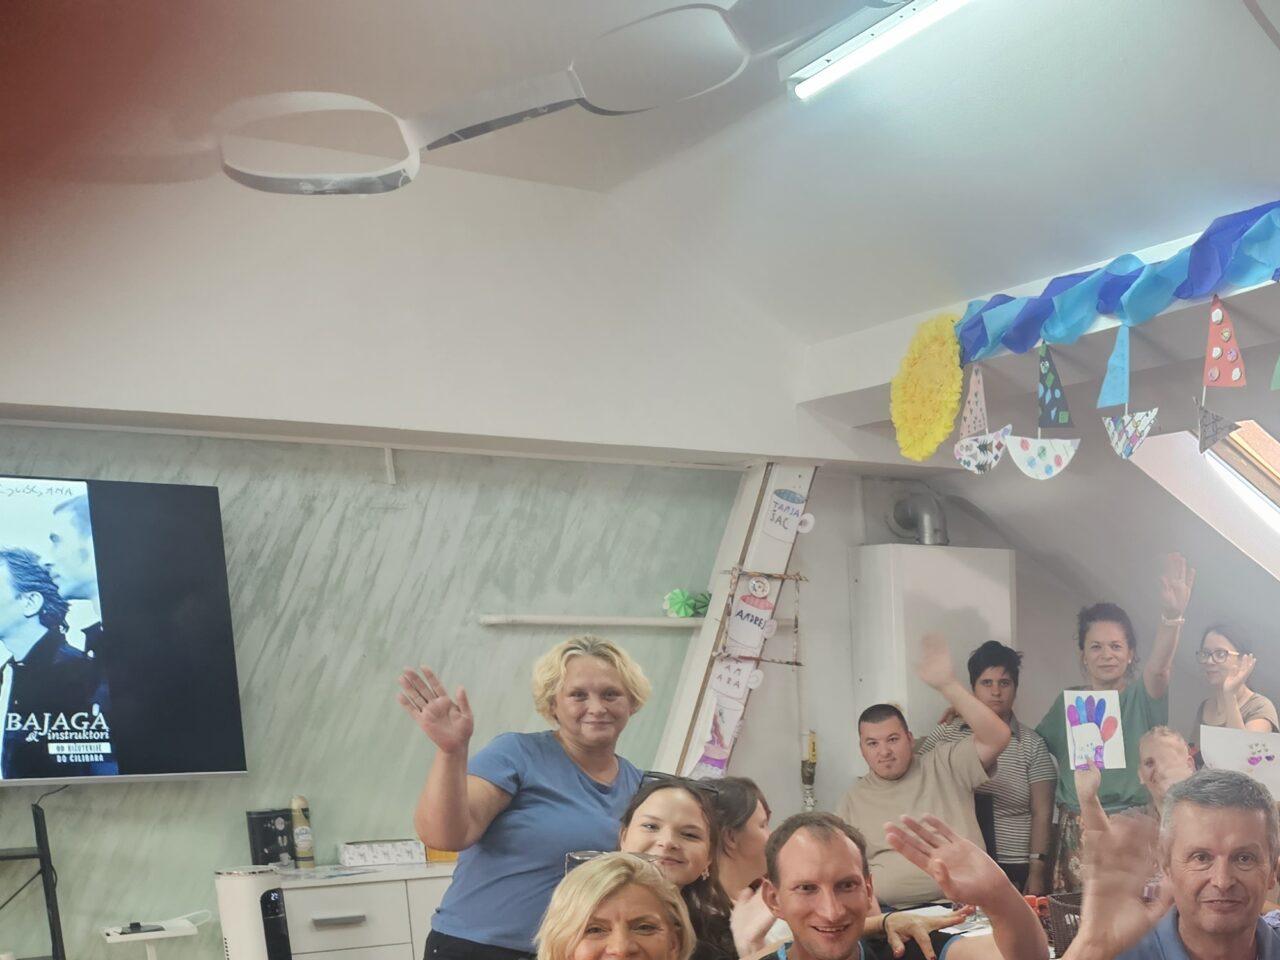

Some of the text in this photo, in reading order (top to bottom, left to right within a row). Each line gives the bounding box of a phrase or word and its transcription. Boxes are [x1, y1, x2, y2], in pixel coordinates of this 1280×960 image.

[735, 609, 768, 631] ANDREJ
[6, 711, 110, 736] BAJAGA
[47, 729, 110, 741] instruktori
